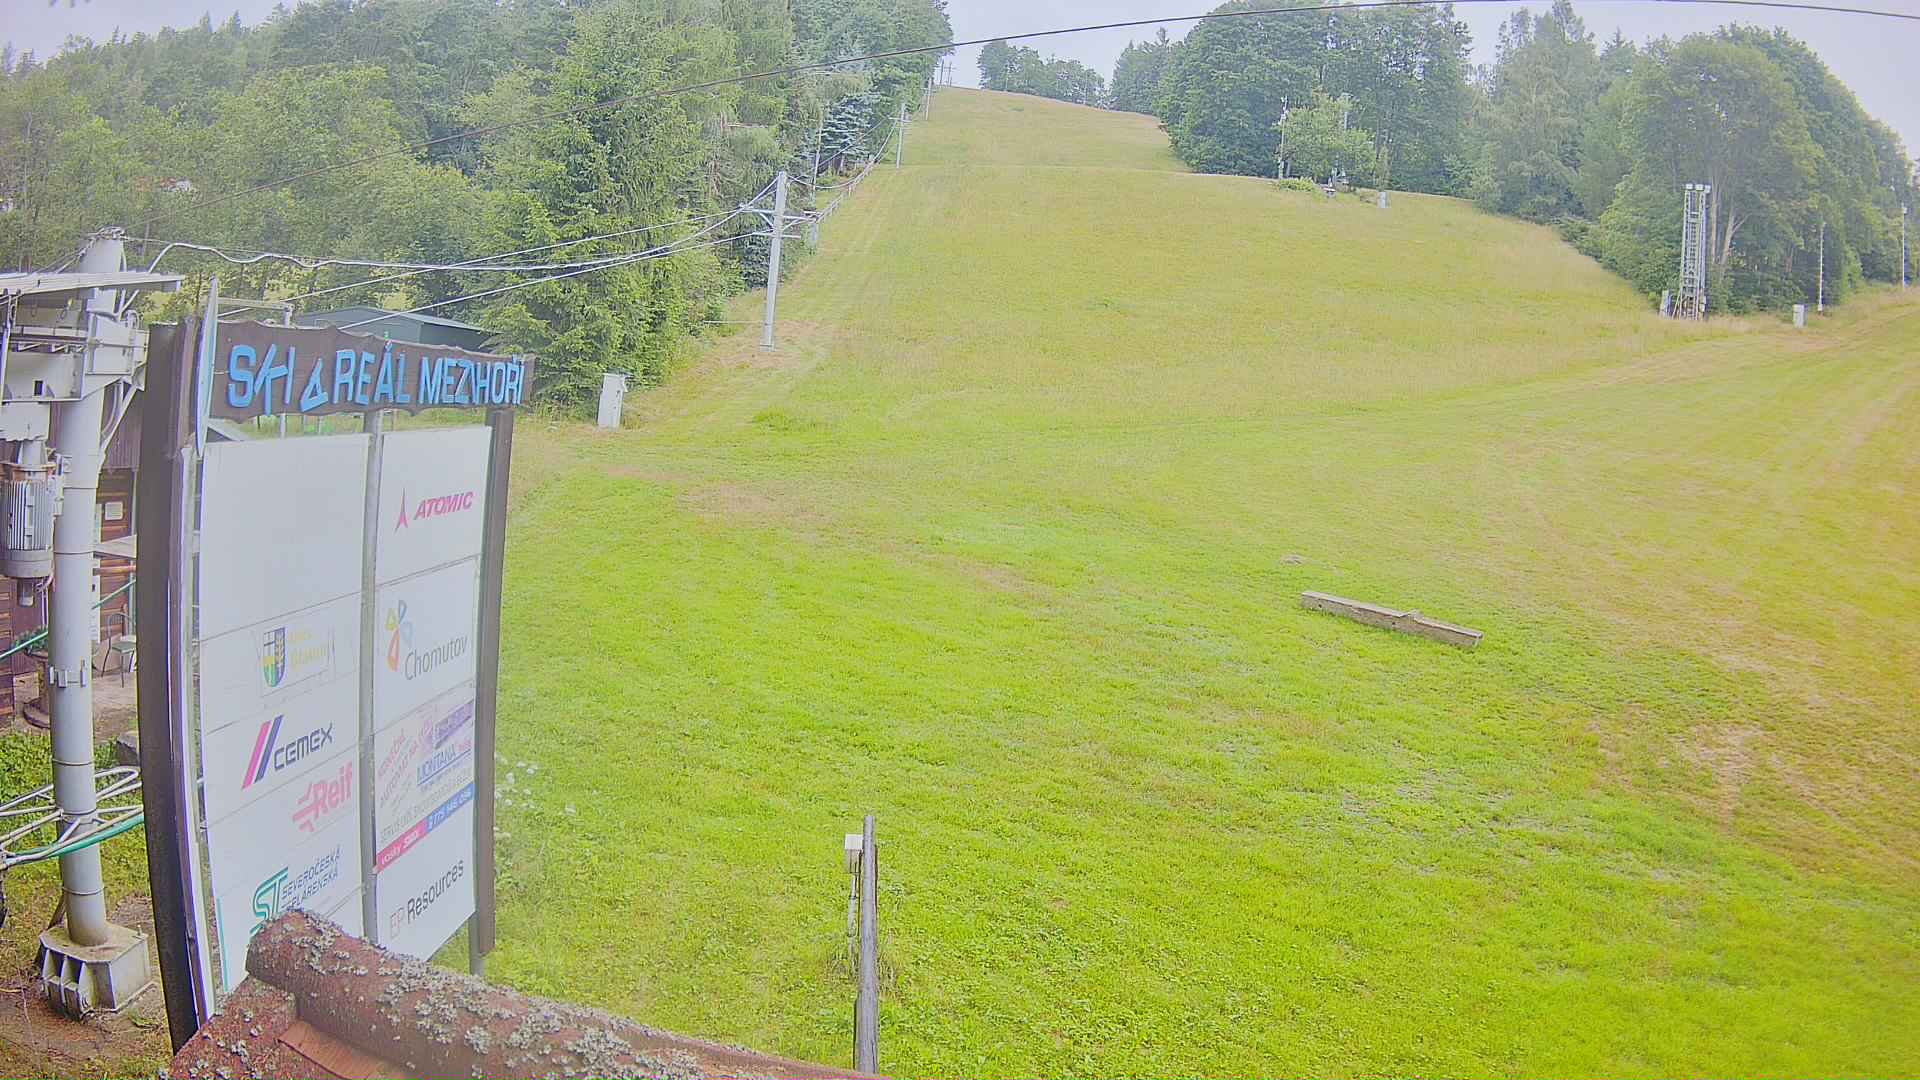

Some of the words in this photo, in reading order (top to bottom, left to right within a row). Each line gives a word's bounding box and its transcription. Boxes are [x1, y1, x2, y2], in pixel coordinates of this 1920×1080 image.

[228, 343, 296, 417] SKI
[413, 491, 475, 521] ATOMIC
[404, 634, 468, 681] Chomutov
[273, 721, 334, 772] CEMEX
[312, 760, 353, 822] Reif
[407, 859, 464, 925] Resources
